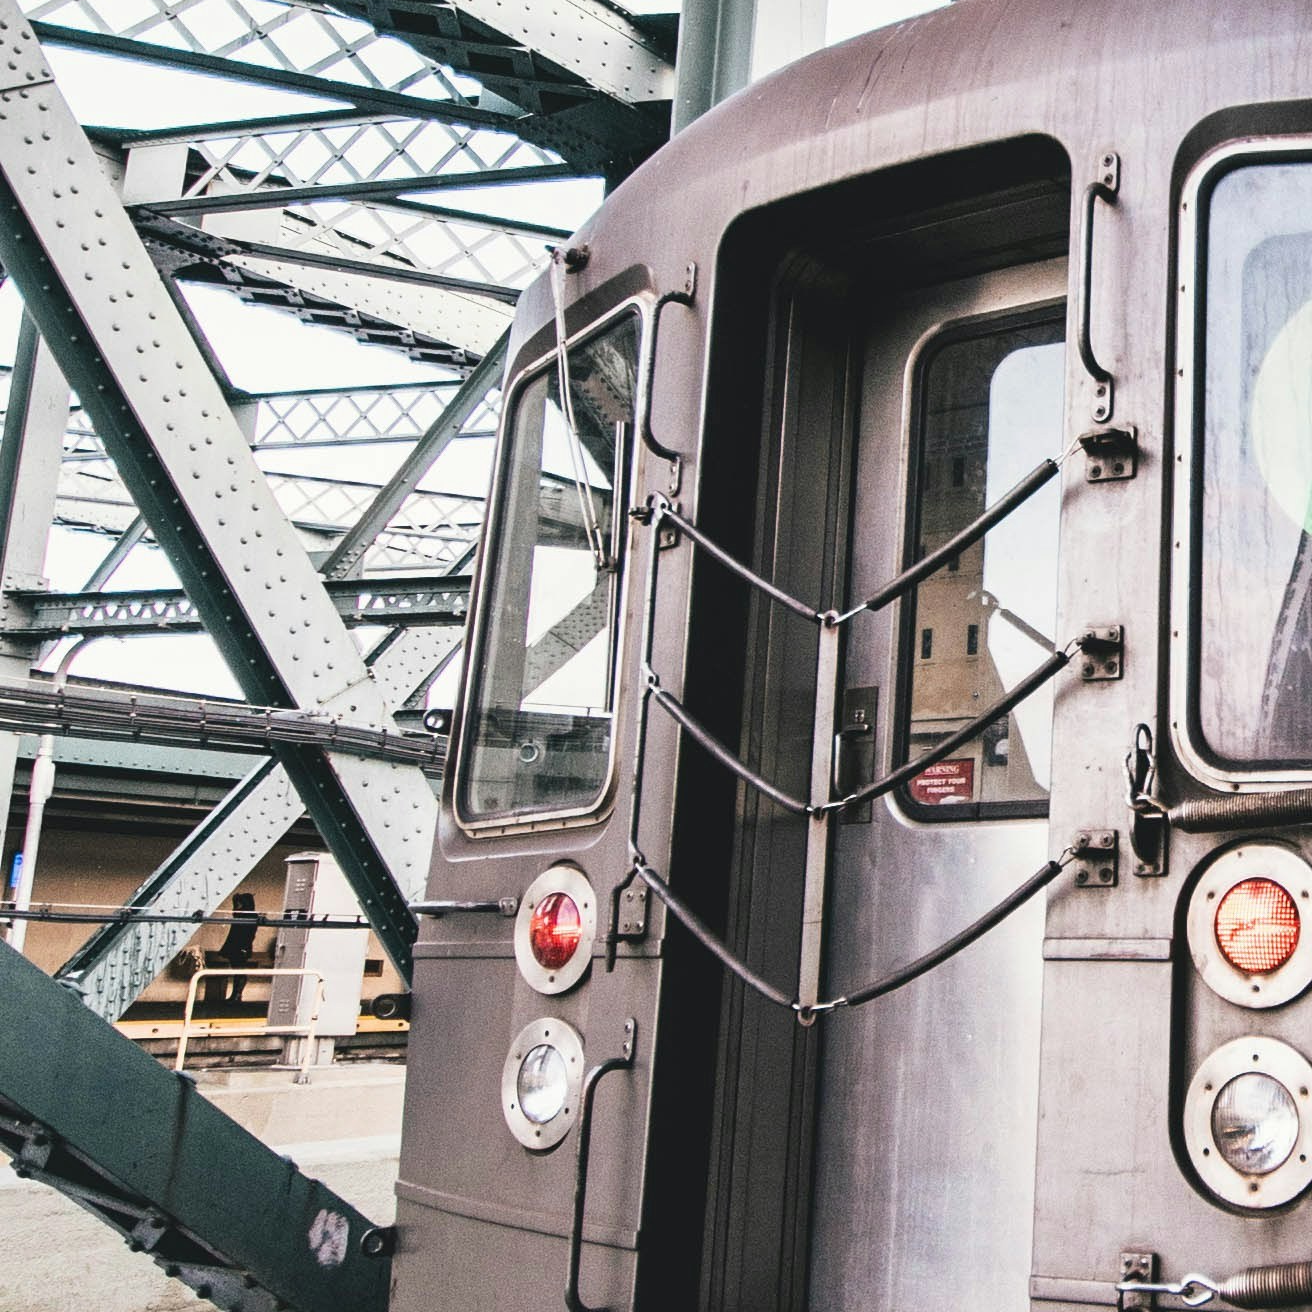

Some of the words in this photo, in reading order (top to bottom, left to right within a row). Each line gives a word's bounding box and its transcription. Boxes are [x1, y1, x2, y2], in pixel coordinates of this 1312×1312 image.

[916, 778, 946, 786] PROTECT
[948, 777, 966, 785] YOUR
[926, 786, 955, 794] FINGERS
